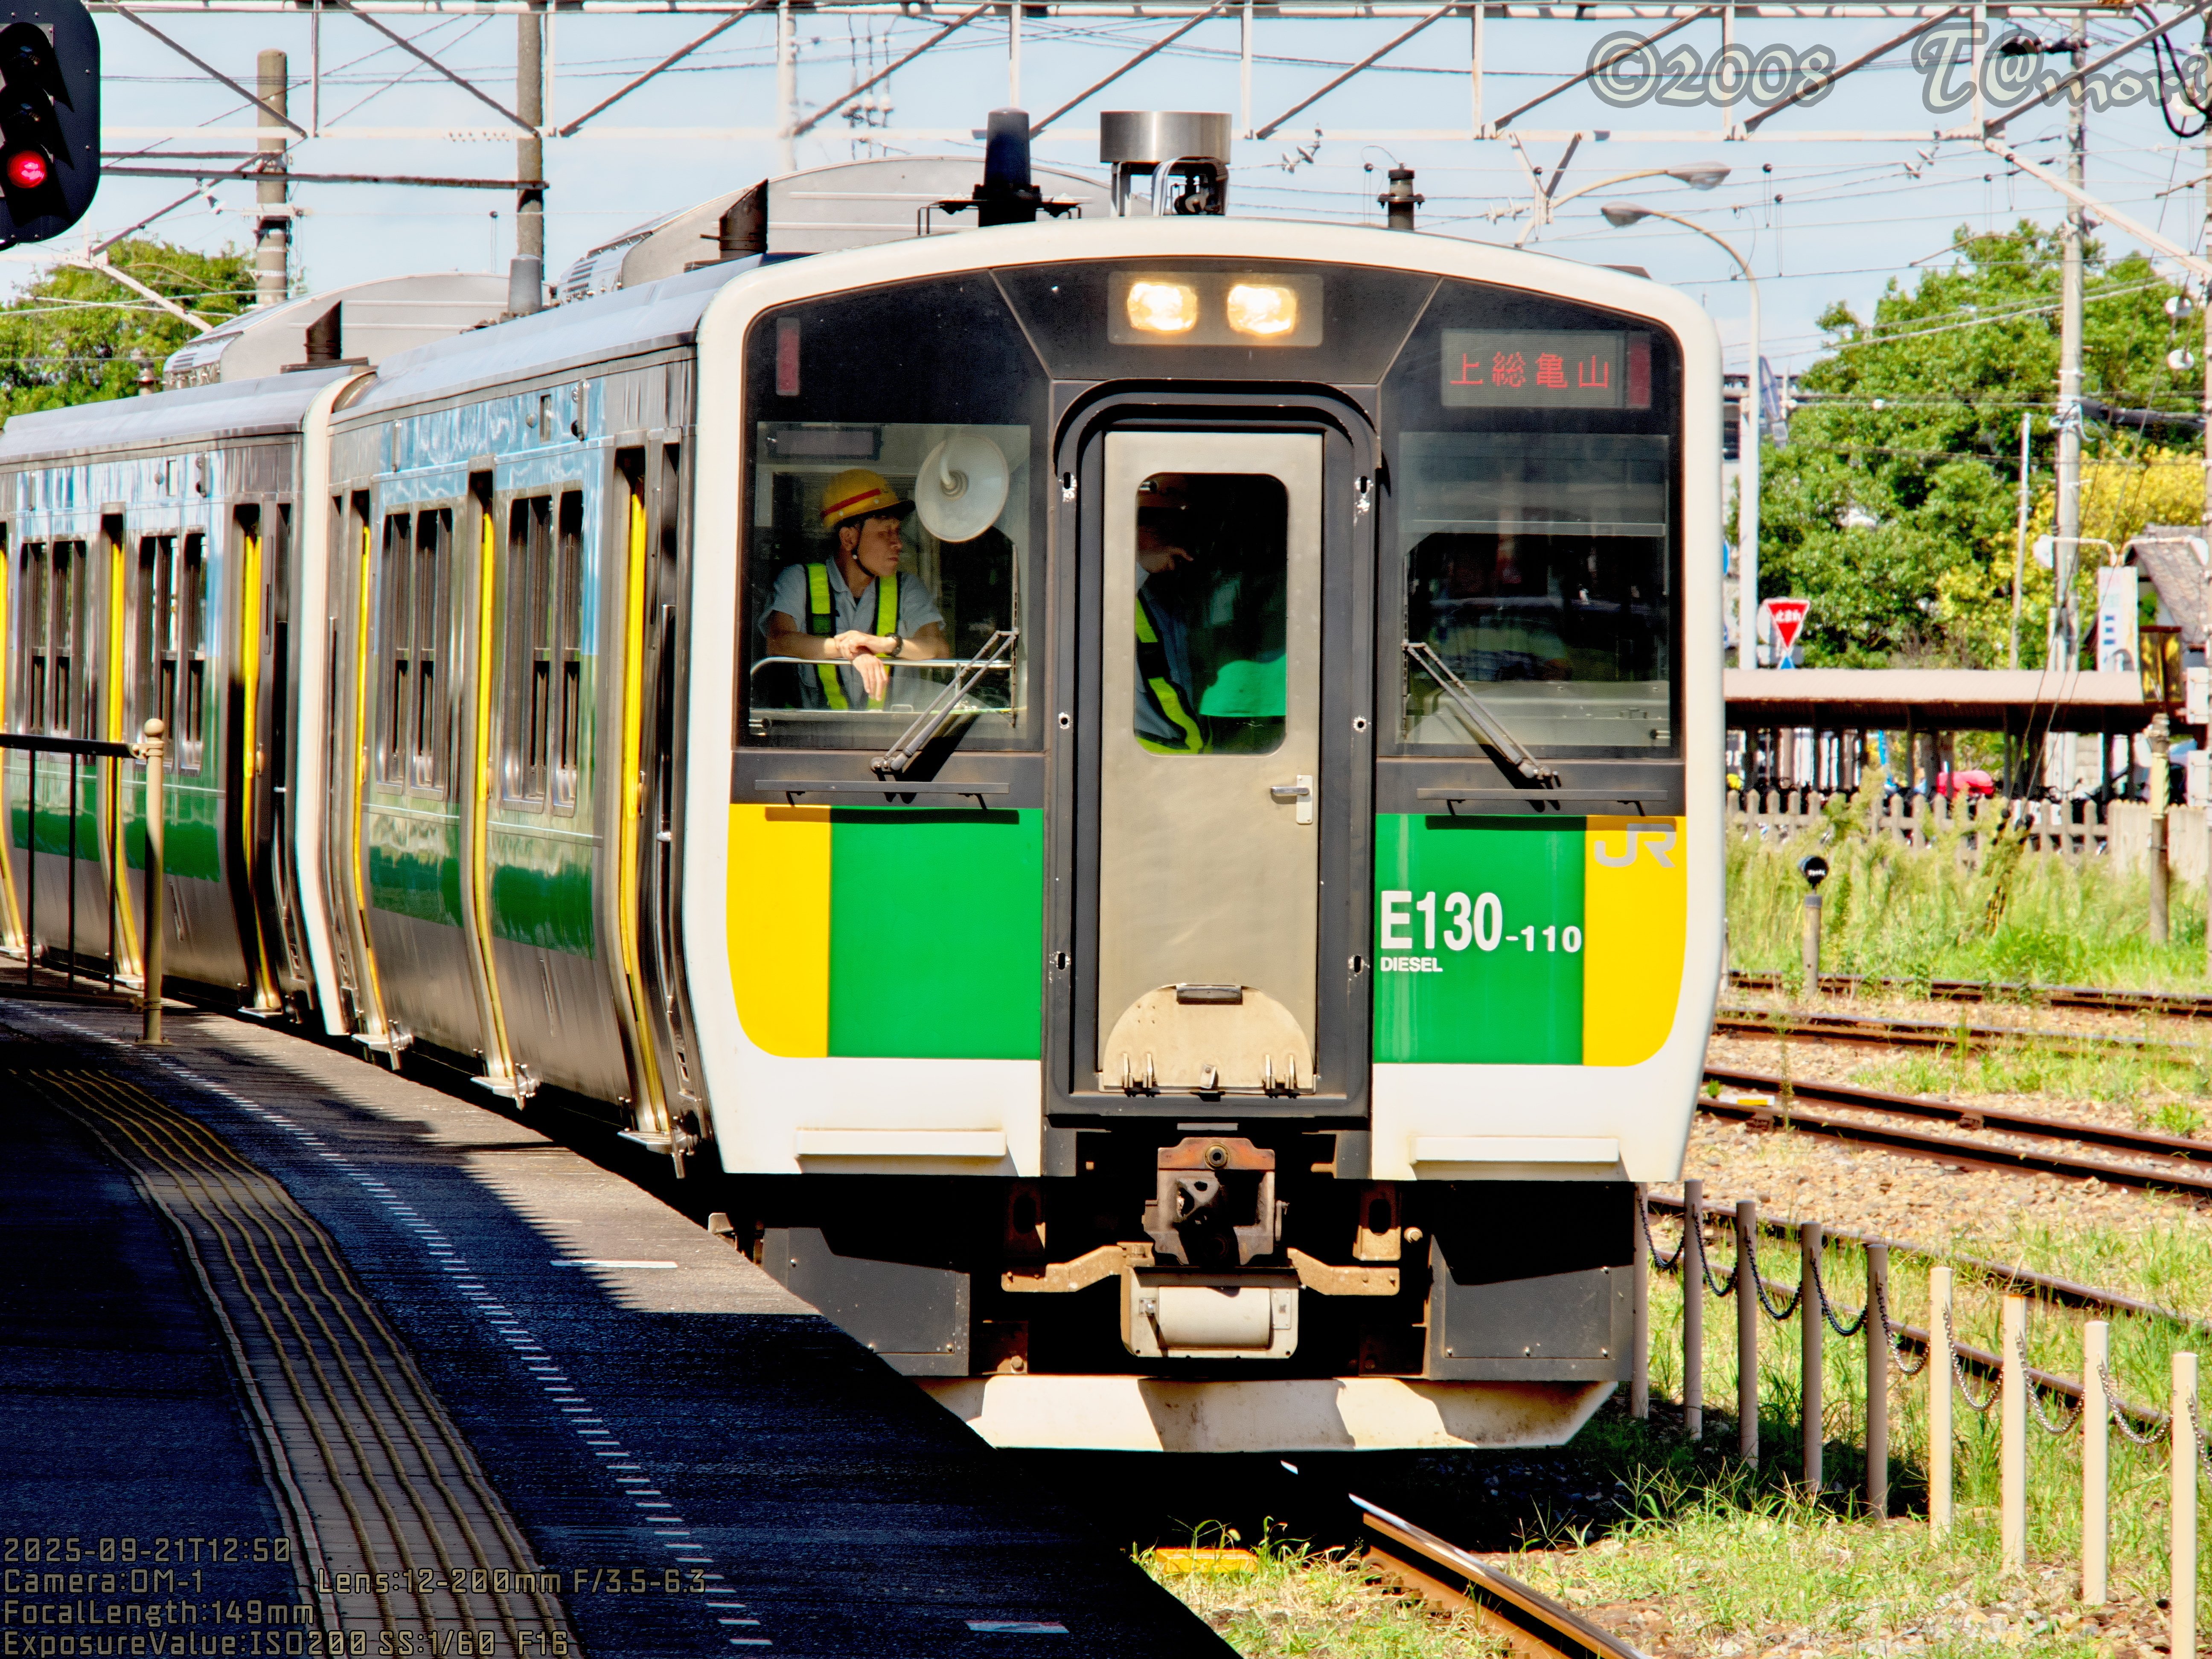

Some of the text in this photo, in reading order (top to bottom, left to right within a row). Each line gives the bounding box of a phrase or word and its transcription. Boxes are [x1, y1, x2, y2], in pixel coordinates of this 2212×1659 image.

[1449, 352, 1610, 389] 上総亀山
[1594, 823, 1676, 868] JR
[1380, 957, 1443, 972] DIESEL
